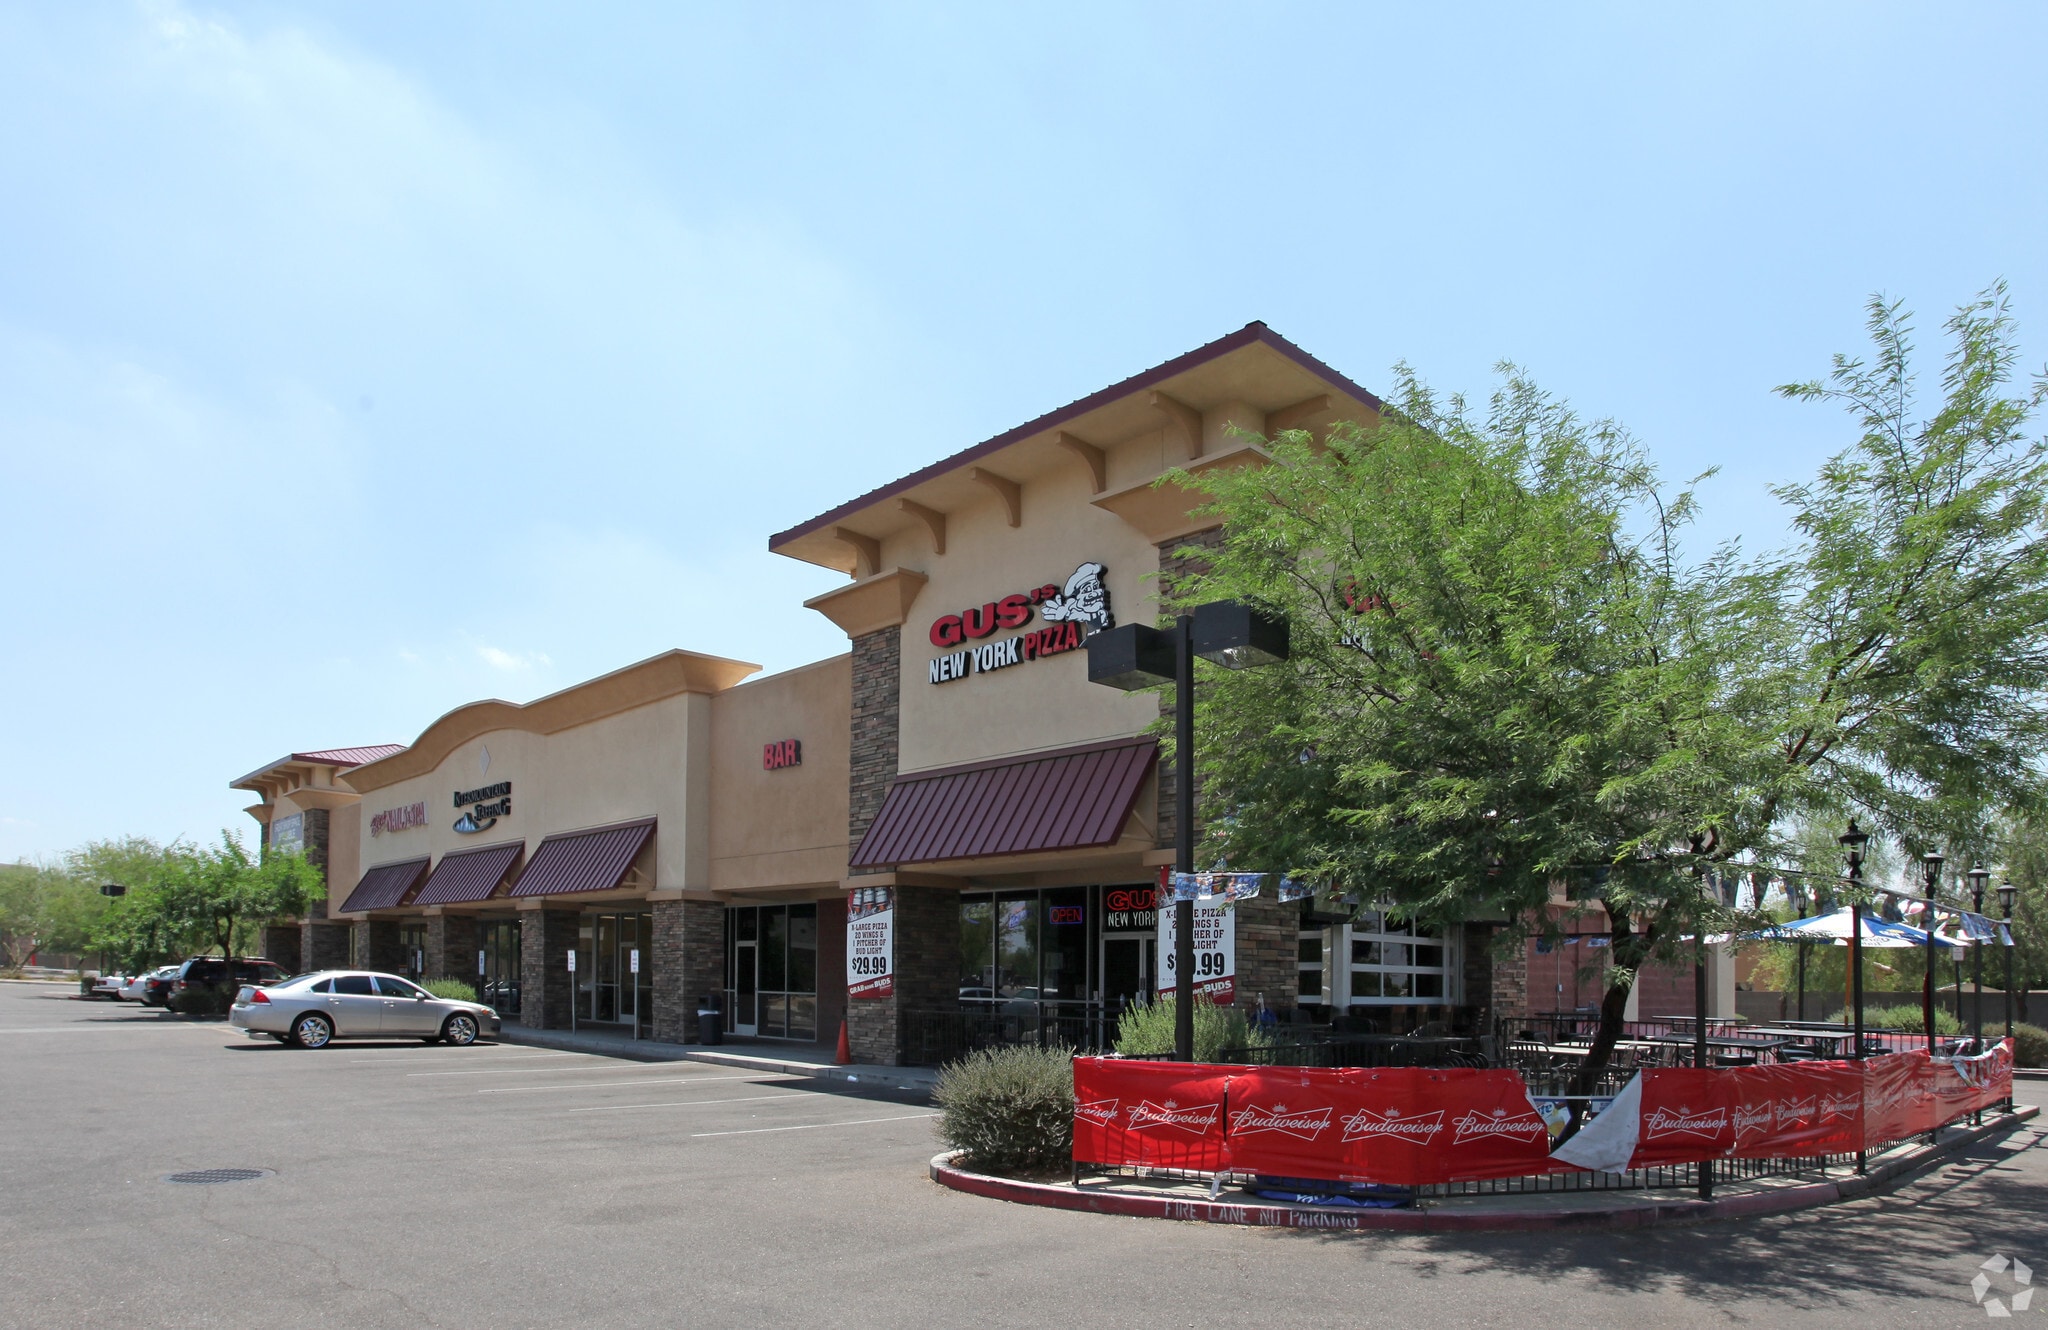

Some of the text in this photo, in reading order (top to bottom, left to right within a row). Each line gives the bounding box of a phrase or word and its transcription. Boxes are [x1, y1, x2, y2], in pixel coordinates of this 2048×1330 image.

[929, 621, 1080, 684] NEW YORK PIZZA
[763, 739, 798, 770] BAR
[1051, 909, 1081, 923] OPEN
[1107, 911, 1129, 927] NEW
[1201, 907, 1227, 918] PIZZA
[872, 922, 888, 930] PIZZA
[1214, 919, 1220, 928] &
[855, 931, 862, 939] 20
[863, 931, 878, 939] WINGS
[879, 938, 887, 946] OF
[1213, 929, 1225, 939] OF
[866, 947, 883, 955] LIGHT
[852, 956, 887, 975] $29.99
[1167, 952, 1225, 976] $.99
[873, 977, 891, 988] BUDS
[1204, 980, 1233, 993] BUDS
[1126, 1105, 1217, 1125] Budweiser
[1229, 1111, 1331, 1130] Budweiser
[1775, 1104, 1817, 1121] Budweiser
[1340, 1114, 1443, 1134] Budweiser
[1452, 1117, 1545, 1134] Budweiser
[1643, 1113, 1728, 1130] Budweiser
[1165, 1201, 1359, 1228] FIRE LANE NO PARKING
